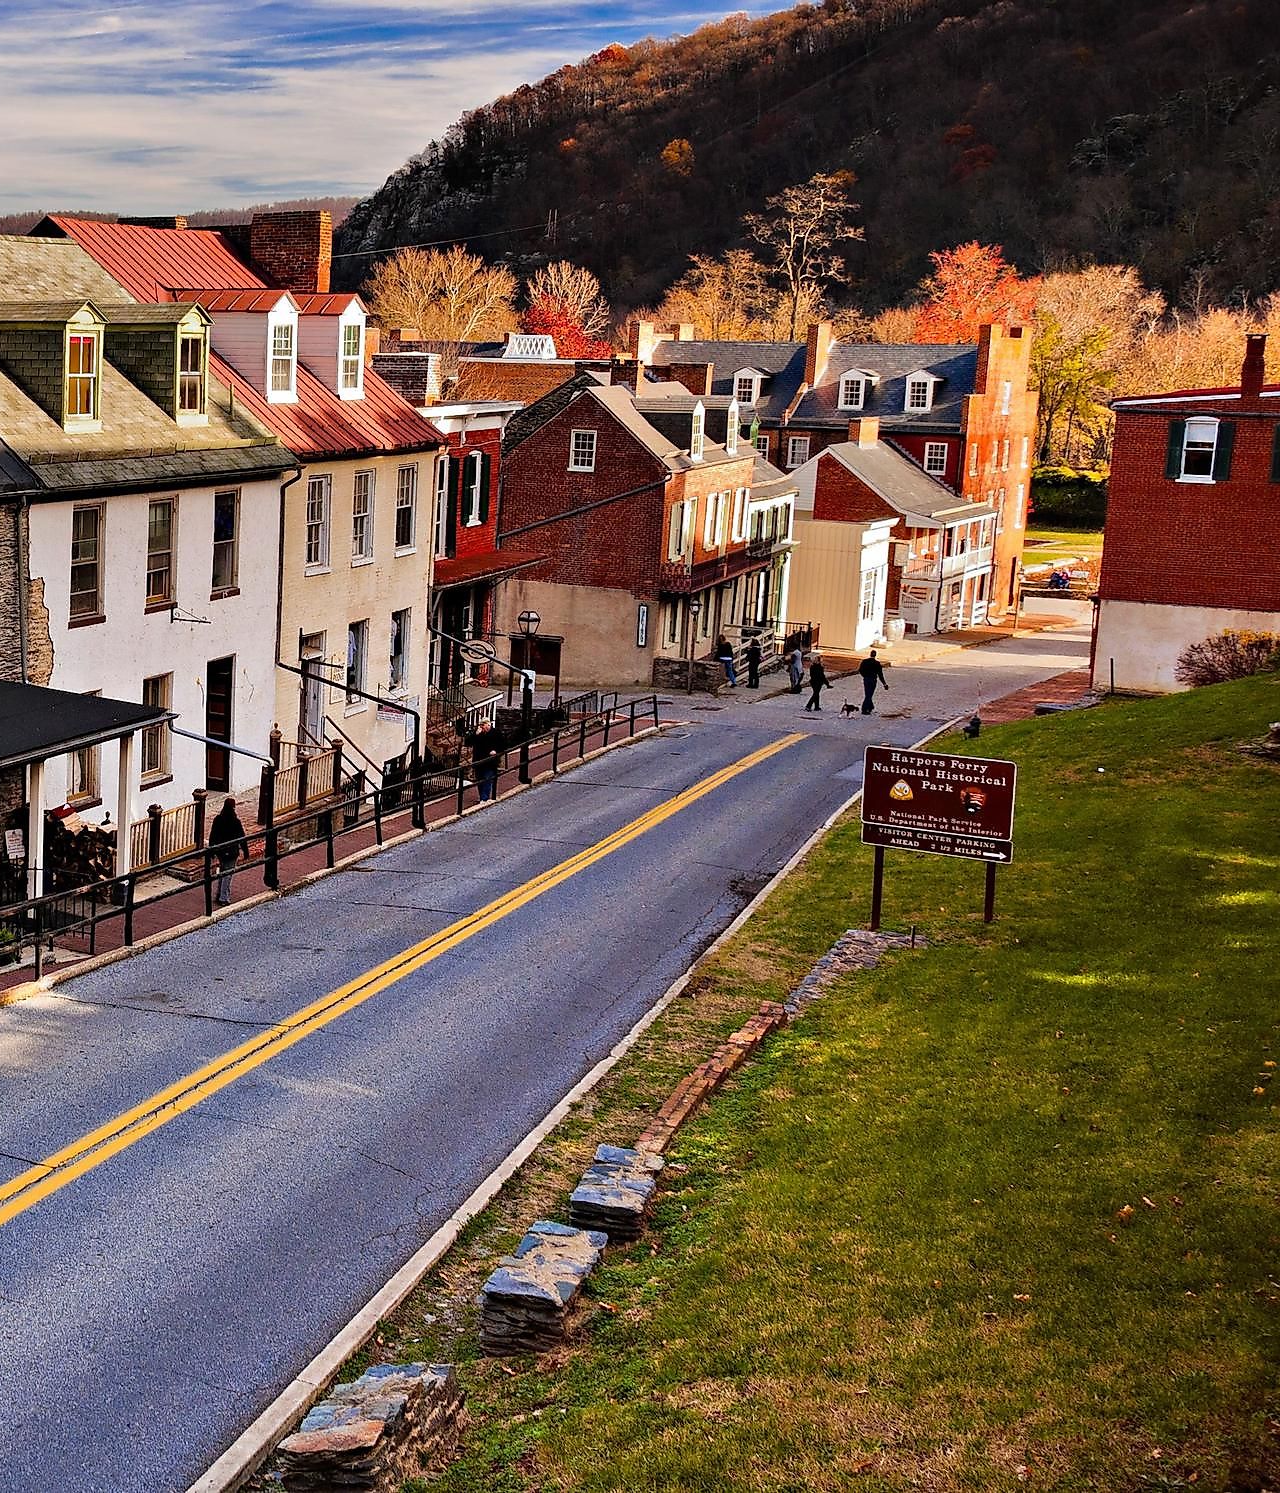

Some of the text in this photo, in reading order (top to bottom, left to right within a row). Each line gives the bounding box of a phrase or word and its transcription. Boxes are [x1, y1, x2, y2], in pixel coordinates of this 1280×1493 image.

[891, 753, 988, 773] Harpers Ferry
[872, 762, 1006, 786] National Historical
[922, 781, 953, 792] Park
[889, 817, 936, 828] Department
[969, 827, 1003, 836] Interior
[890, 810, 925, 820] National
[951, 818, 981, 827] Service
[879, 828, 995, 848] VISITOR CENTER PARKING
[890, 838, 919, 847] AHEAD
[954, 847, 981, 856] MILES
